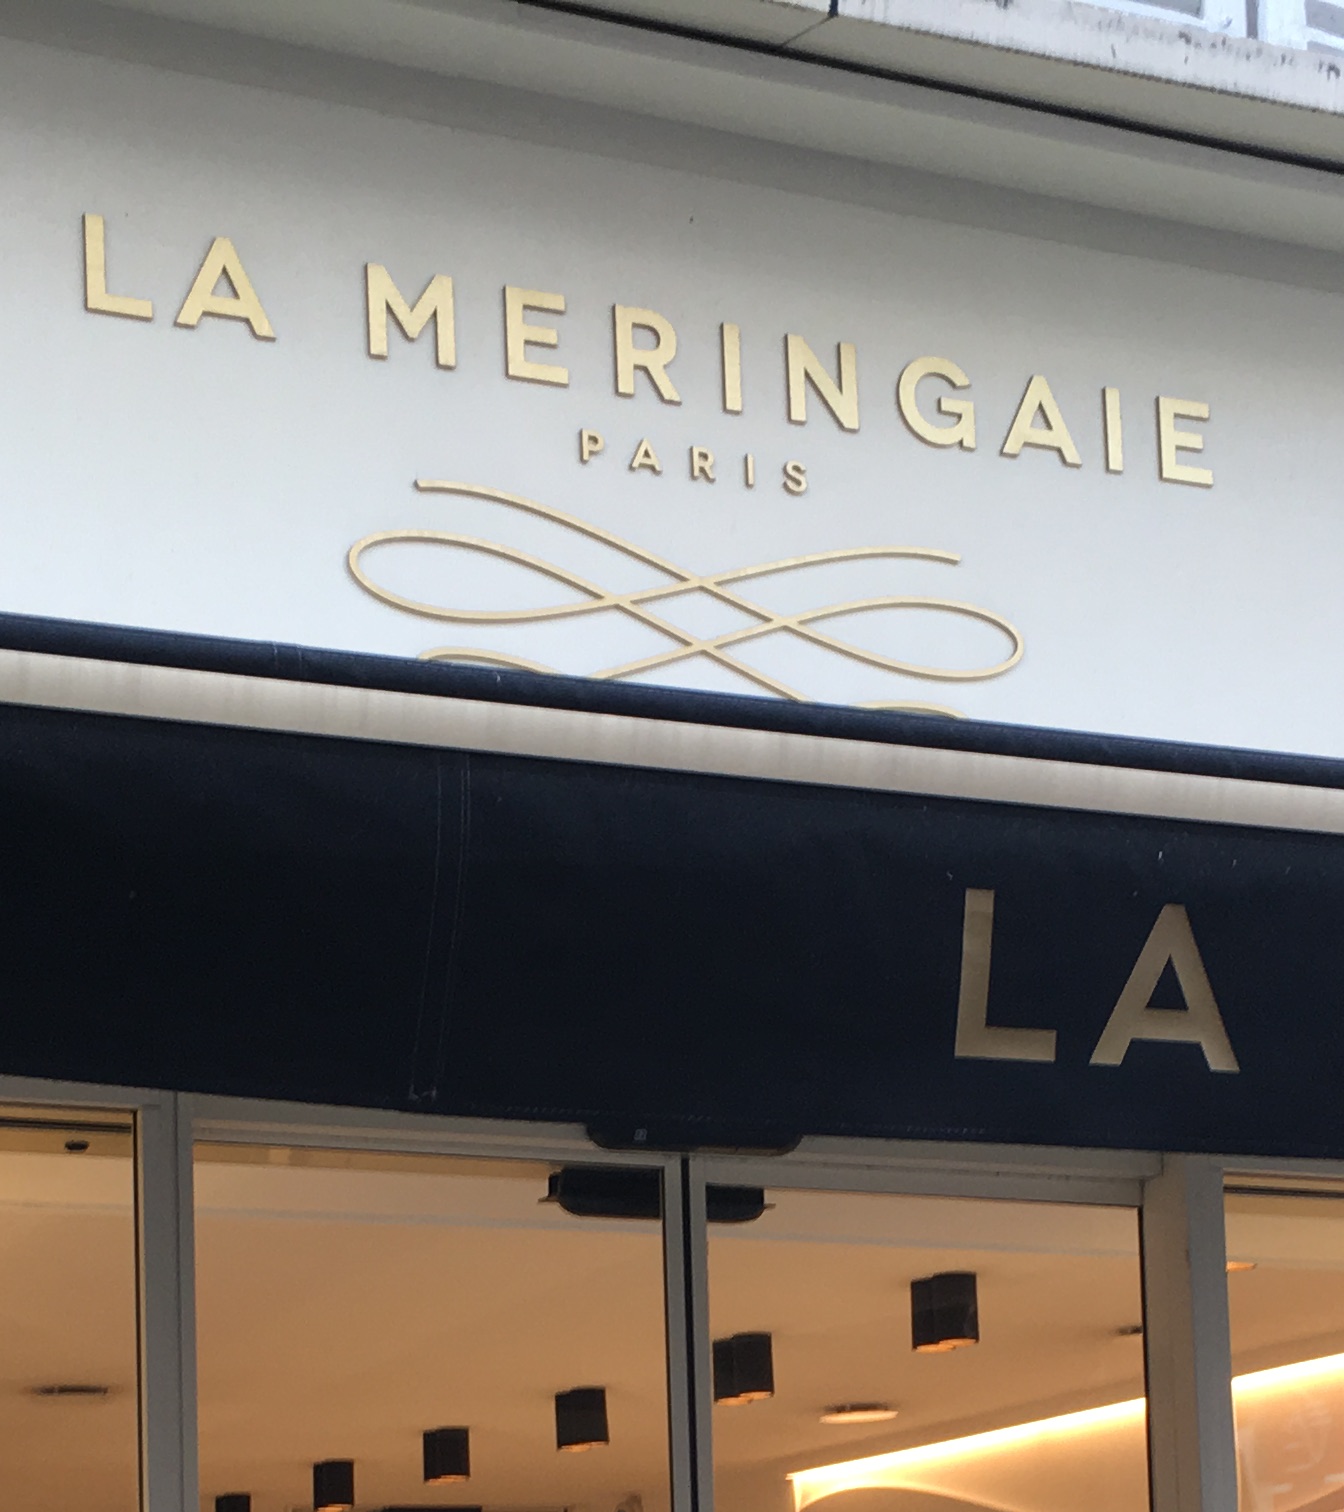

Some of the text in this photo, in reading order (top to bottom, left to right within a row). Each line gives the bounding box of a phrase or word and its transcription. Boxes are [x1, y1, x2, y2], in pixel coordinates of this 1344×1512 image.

[82, 212, 1215, 488] LA MERINGAIE
[579, 427, 809, 495] PARIS
[952, 887, 1242, 1074] LA
